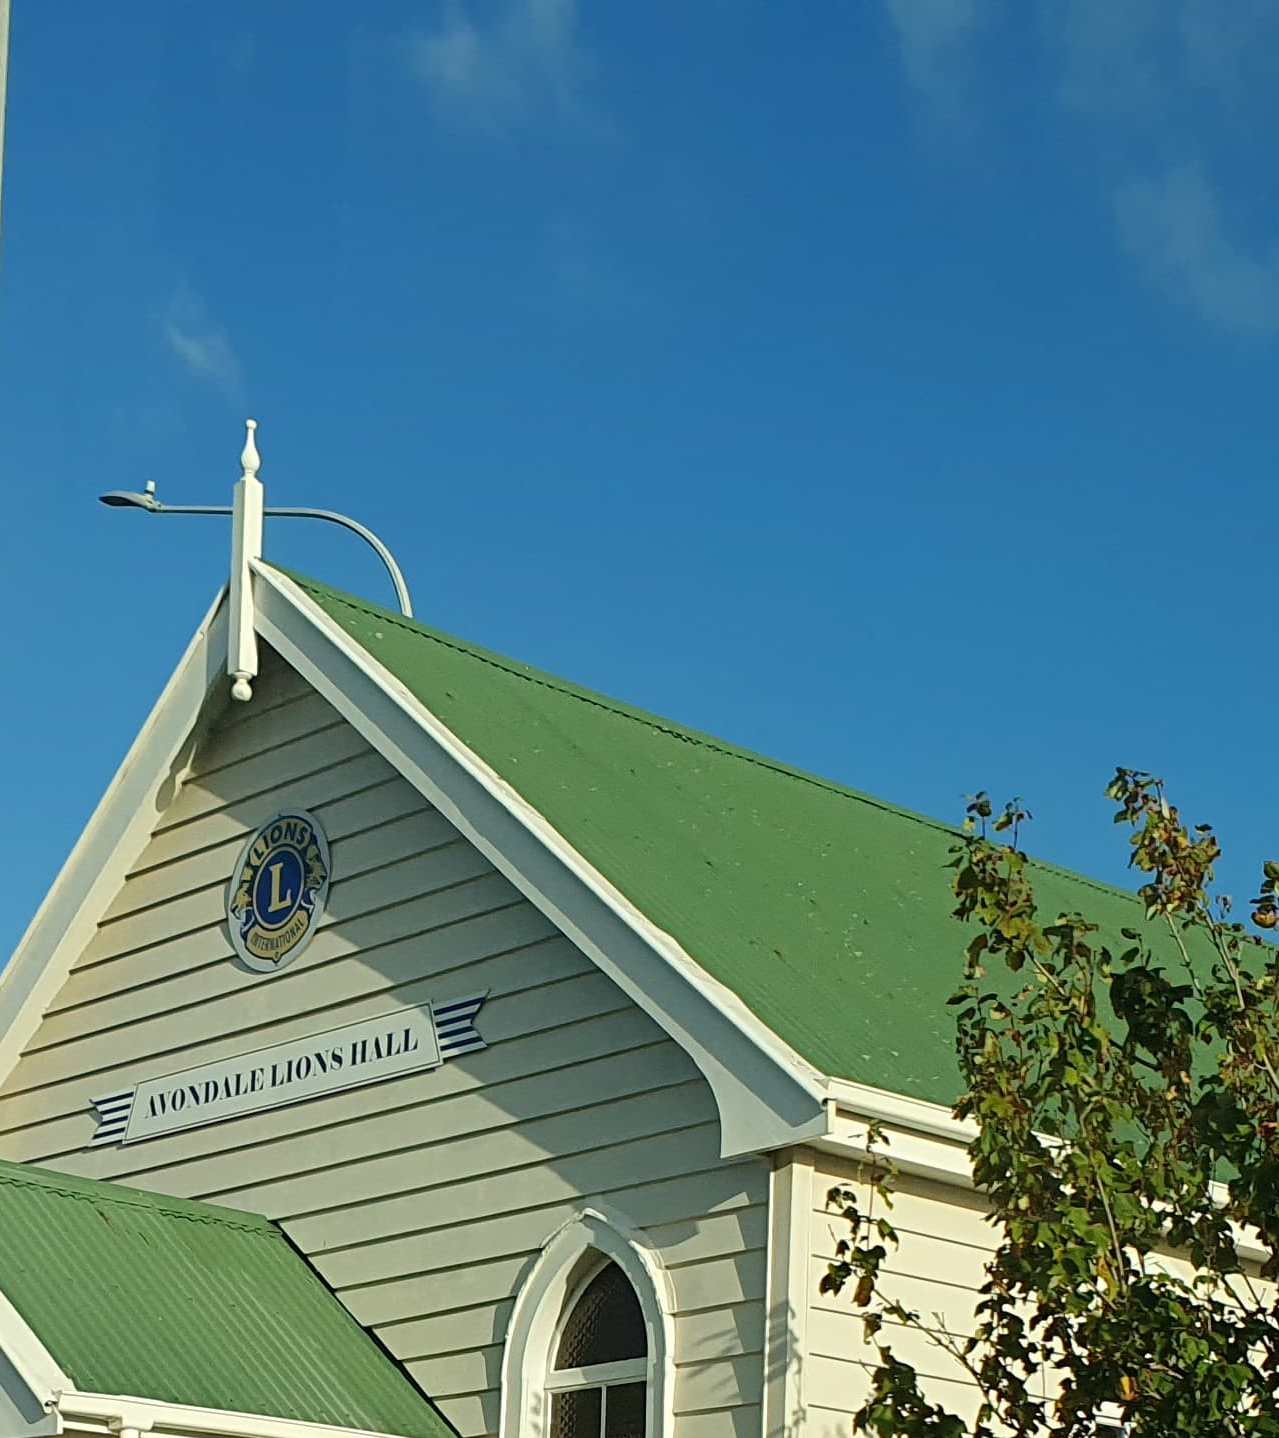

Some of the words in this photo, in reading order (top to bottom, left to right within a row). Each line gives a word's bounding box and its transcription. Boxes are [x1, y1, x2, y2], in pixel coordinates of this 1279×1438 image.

[253, 822, 308, 861] LIONS
[268, 862, 292, 913] L
[250, 918, 304, 951] INTERNATIONAL
[145, 1067, 265, 1119] AVONDALE
[270, 1046, 343, 1088] LIONS
[350, 1027, 419, 1066] HALL
